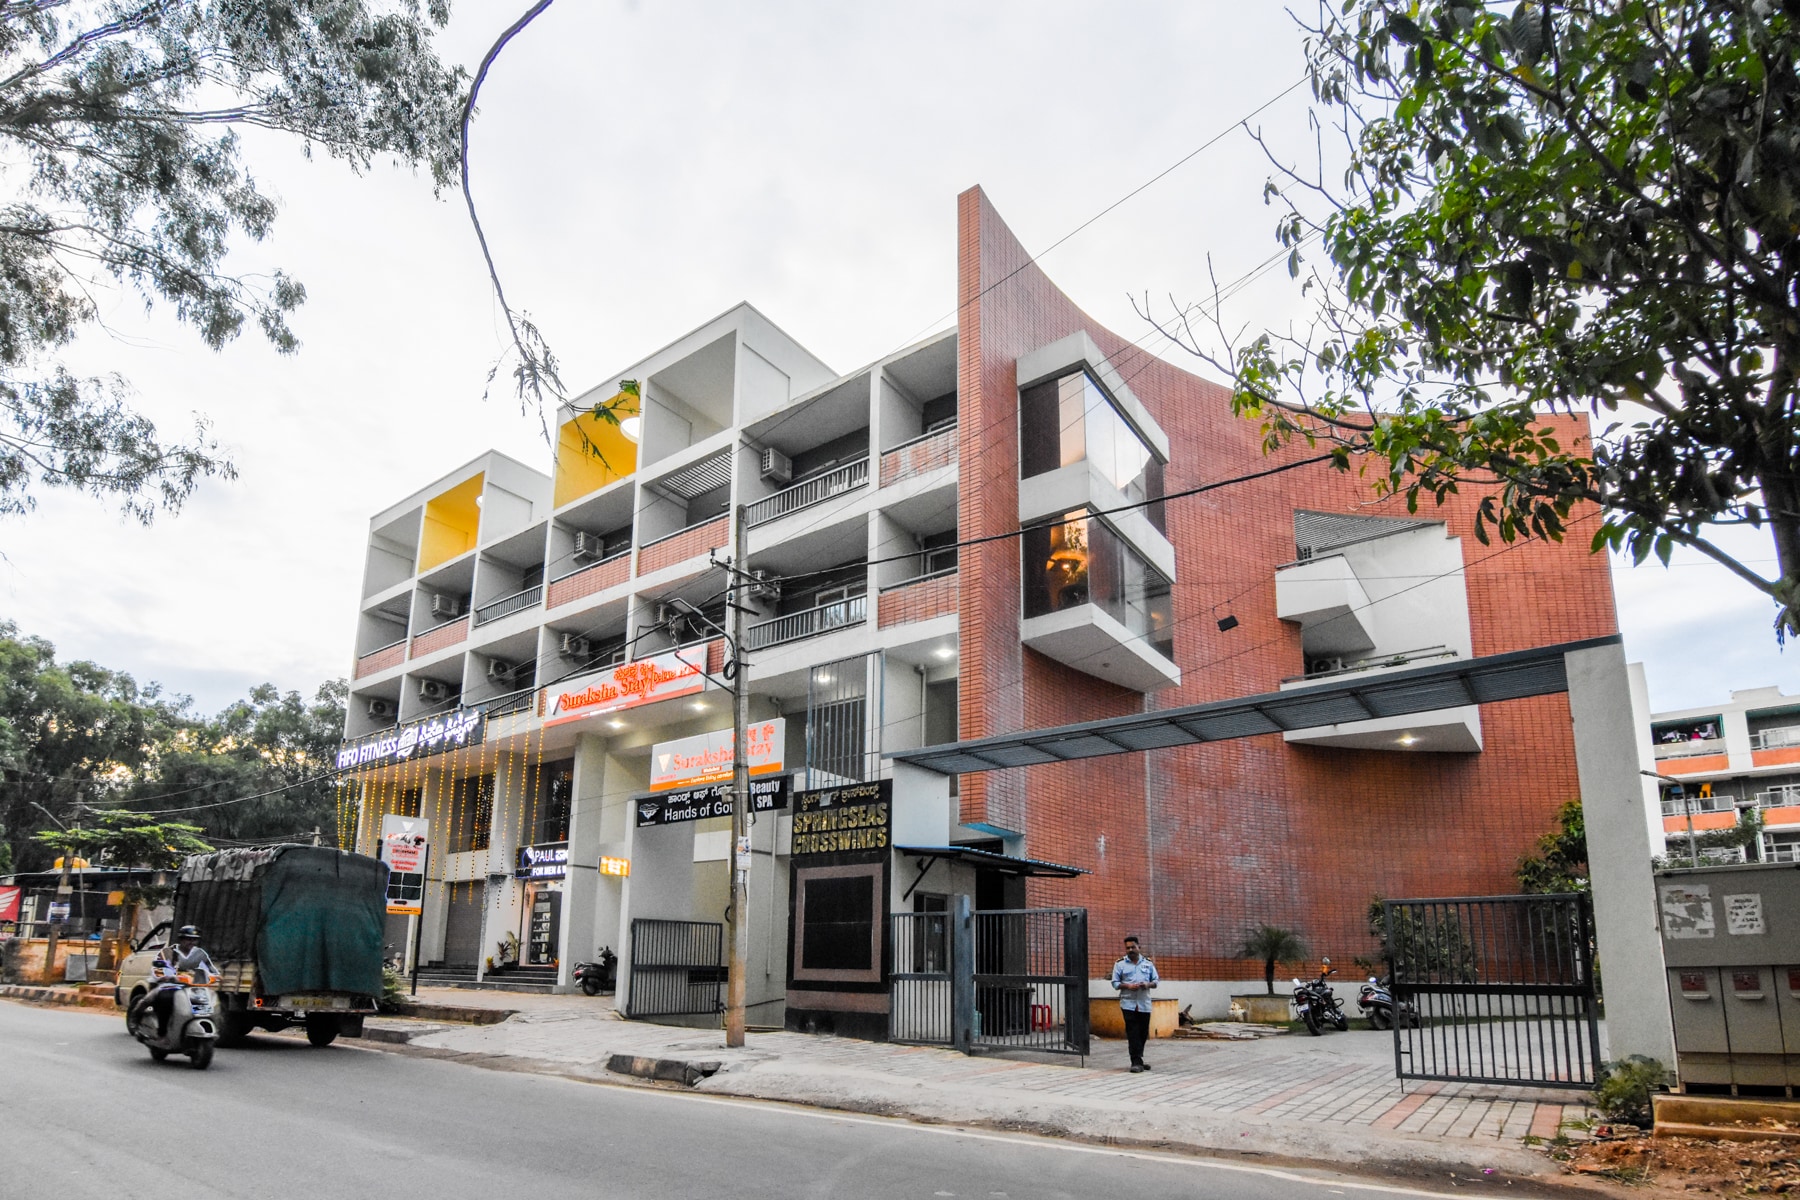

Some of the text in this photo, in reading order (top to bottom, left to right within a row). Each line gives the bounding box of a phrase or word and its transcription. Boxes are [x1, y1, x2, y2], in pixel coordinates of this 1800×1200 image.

[560, 676, 649, 711] Suraksha Stay
[337, 747, 359, 768] FIFO
[359, 737, 398, 763] FITNESS
[673, 742, 774, 771] Suraksha tay
[751, 780, 780, 796] Beauty
[664, 806, 697, 822] Hands
[700, 802, 712, 817] of
[756, 795, 774, 809] SPA
[793, 802, 888, 834] SPRINGSEAS
[792, 826, 888, 855] CROSSWINDS
[534, 848, 555, 863] PAUL
[532, 866, 544, 877] FOR
[544, 865, 557, 876] MEN
